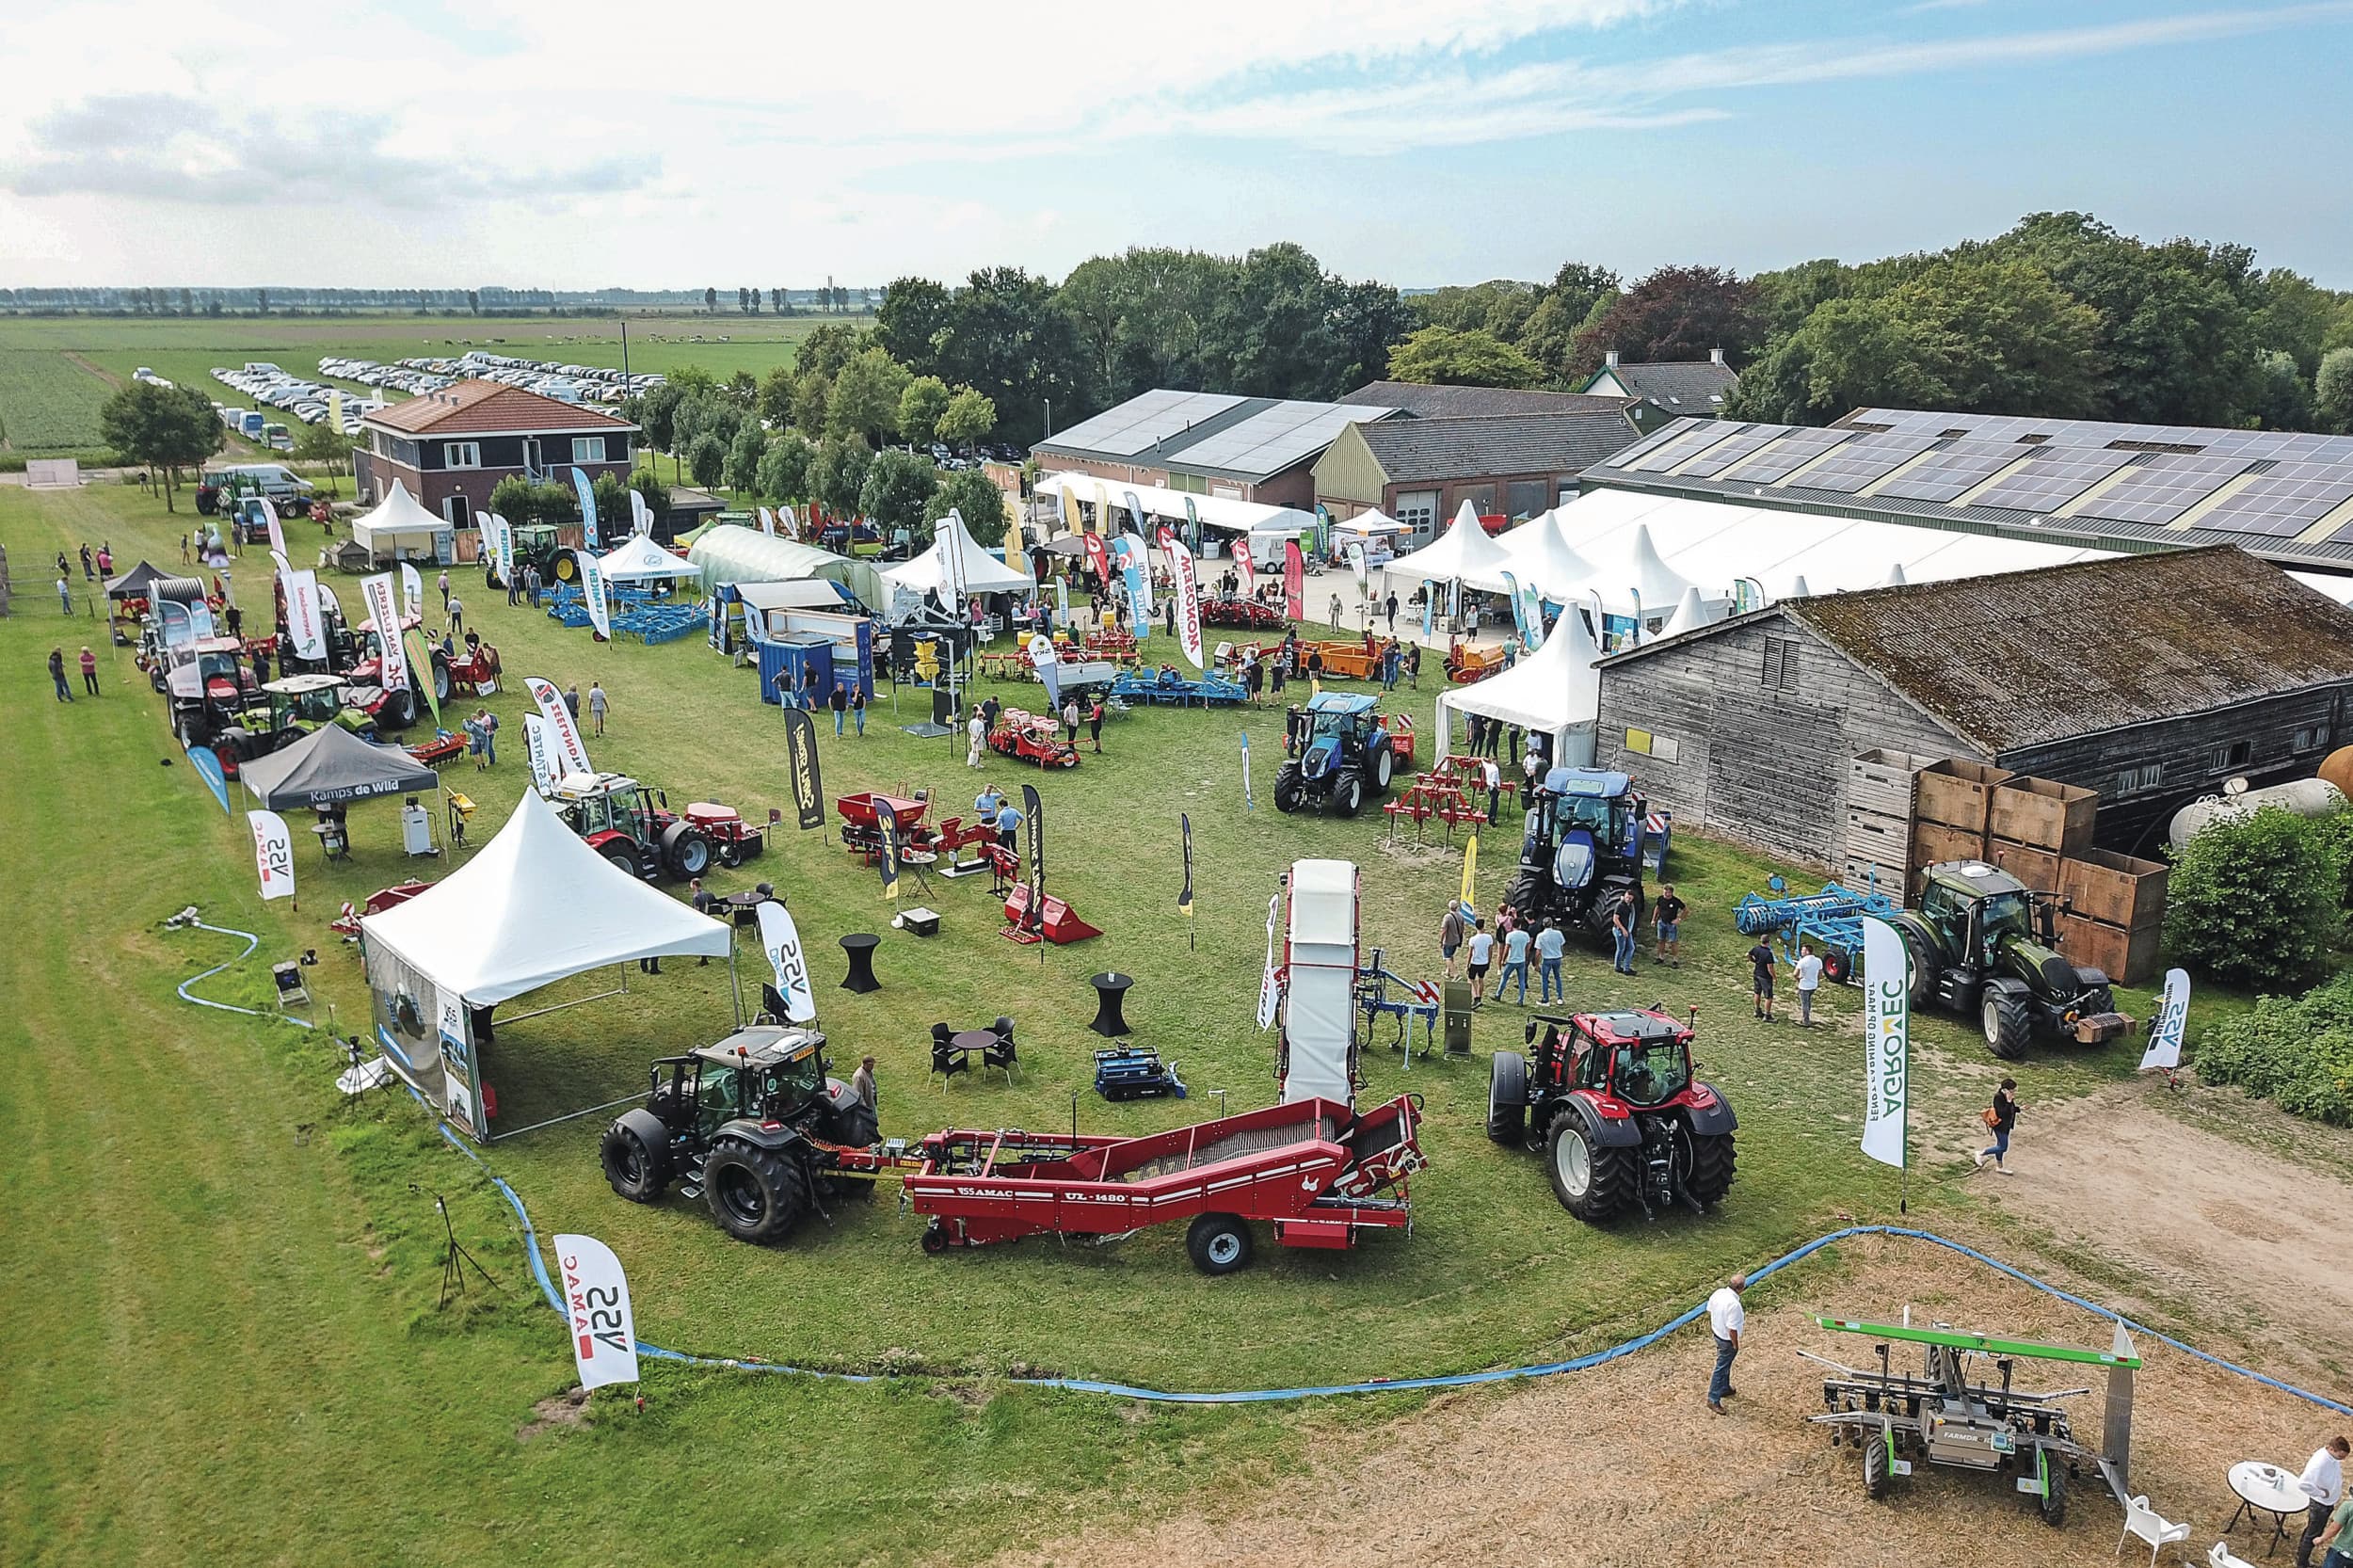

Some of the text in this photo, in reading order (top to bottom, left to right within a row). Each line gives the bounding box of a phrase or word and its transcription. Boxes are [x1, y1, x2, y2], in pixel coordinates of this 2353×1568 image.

[310, 779, 399, 802] Kamps de Wild
